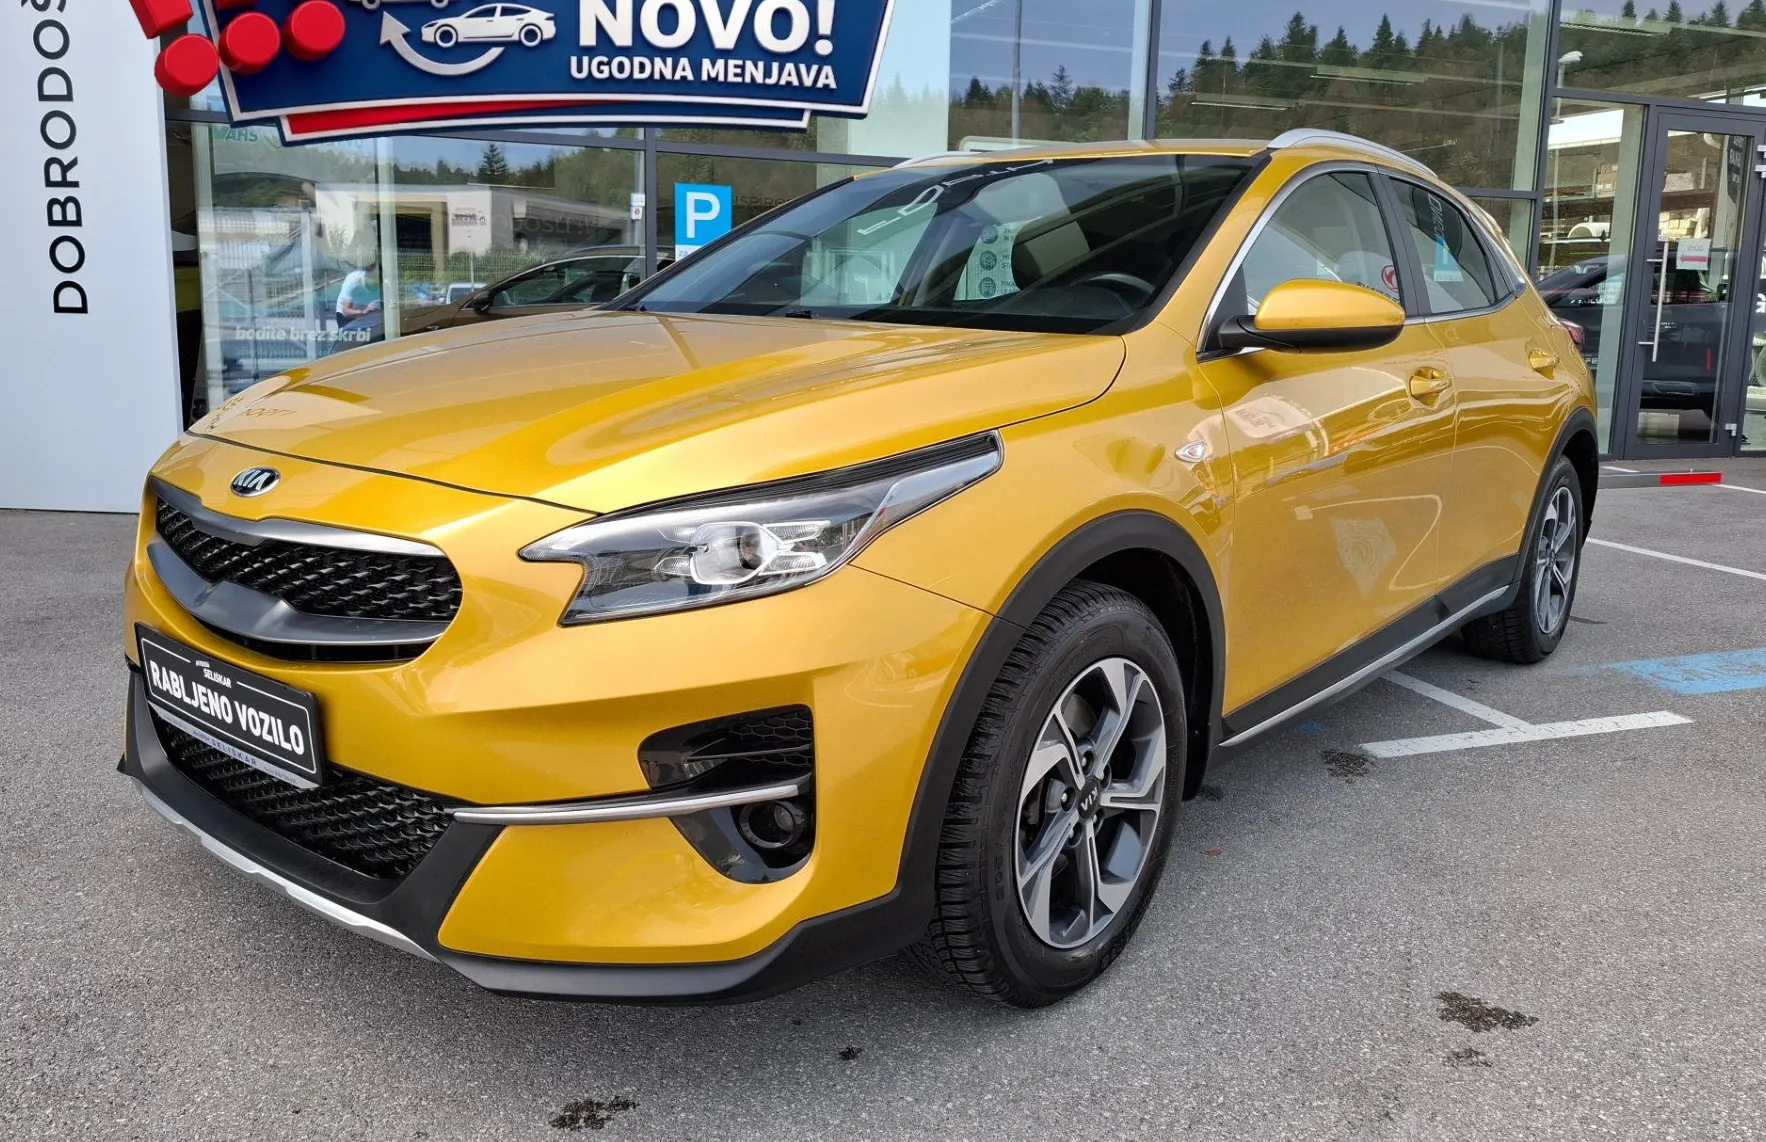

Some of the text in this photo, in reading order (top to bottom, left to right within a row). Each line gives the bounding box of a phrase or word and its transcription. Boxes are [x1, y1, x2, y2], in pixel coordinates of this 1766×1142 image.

[686, 192, 721, 239] P
[289, 327, 326, 342] brez
[327, 327, 372, 342] skrbi
[233, 469, 271, 491] KIA
[149, 660, 304, 756] RABLJENO VOZILO
